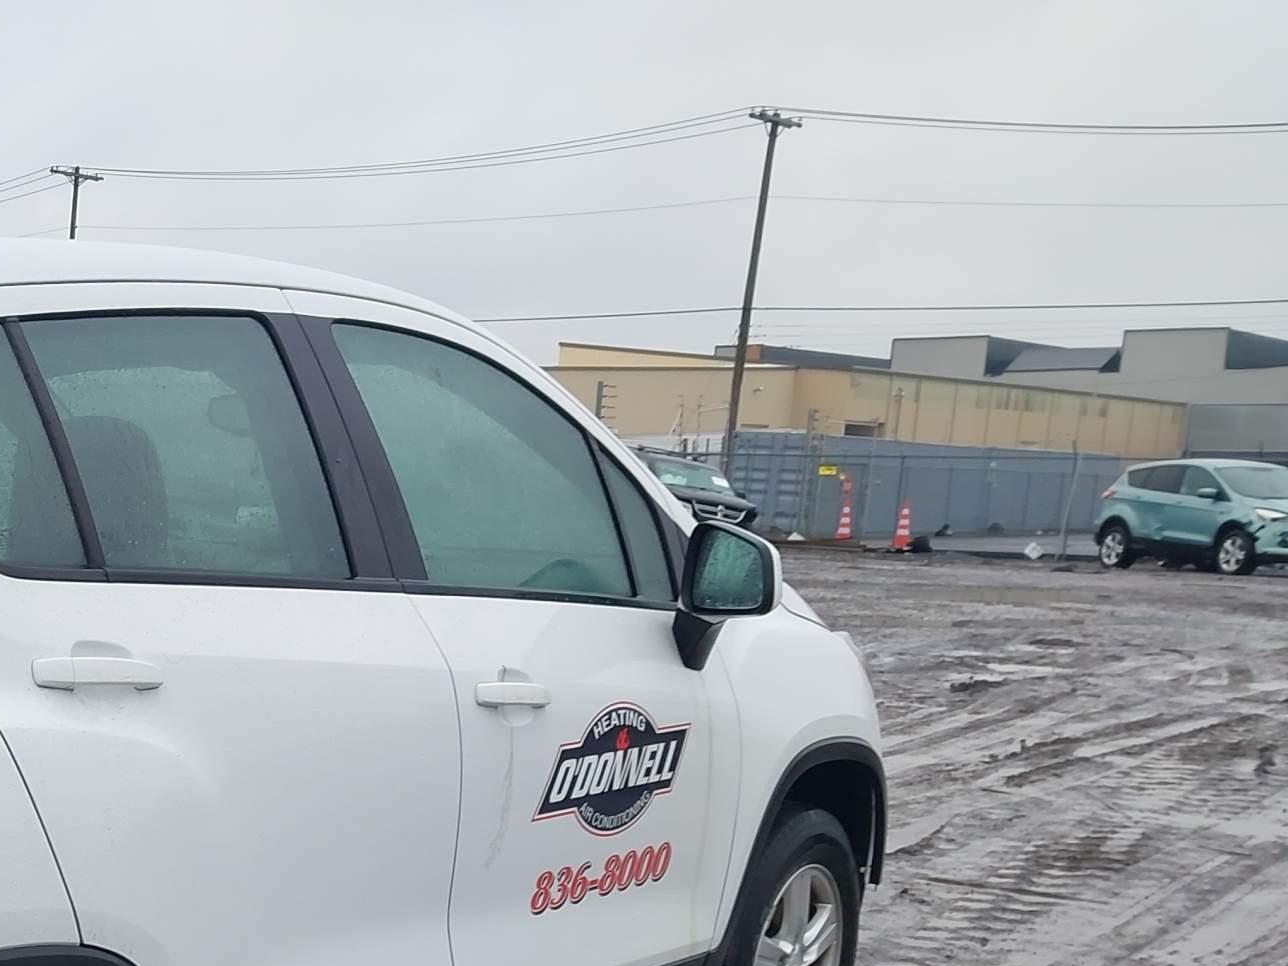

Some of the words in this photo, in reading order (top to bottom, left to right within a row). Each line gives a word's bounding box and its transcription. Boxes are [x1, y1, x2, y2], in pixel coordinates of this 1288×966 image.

[593, 709, 646, 740] HEATING
[549, 740, 678, 803] O'DONNELL
[579, 802, 594, 822] AIR
[592, 790, 650, 828] CONDITIONING
[530, 842, 672, 915] 836-8000
